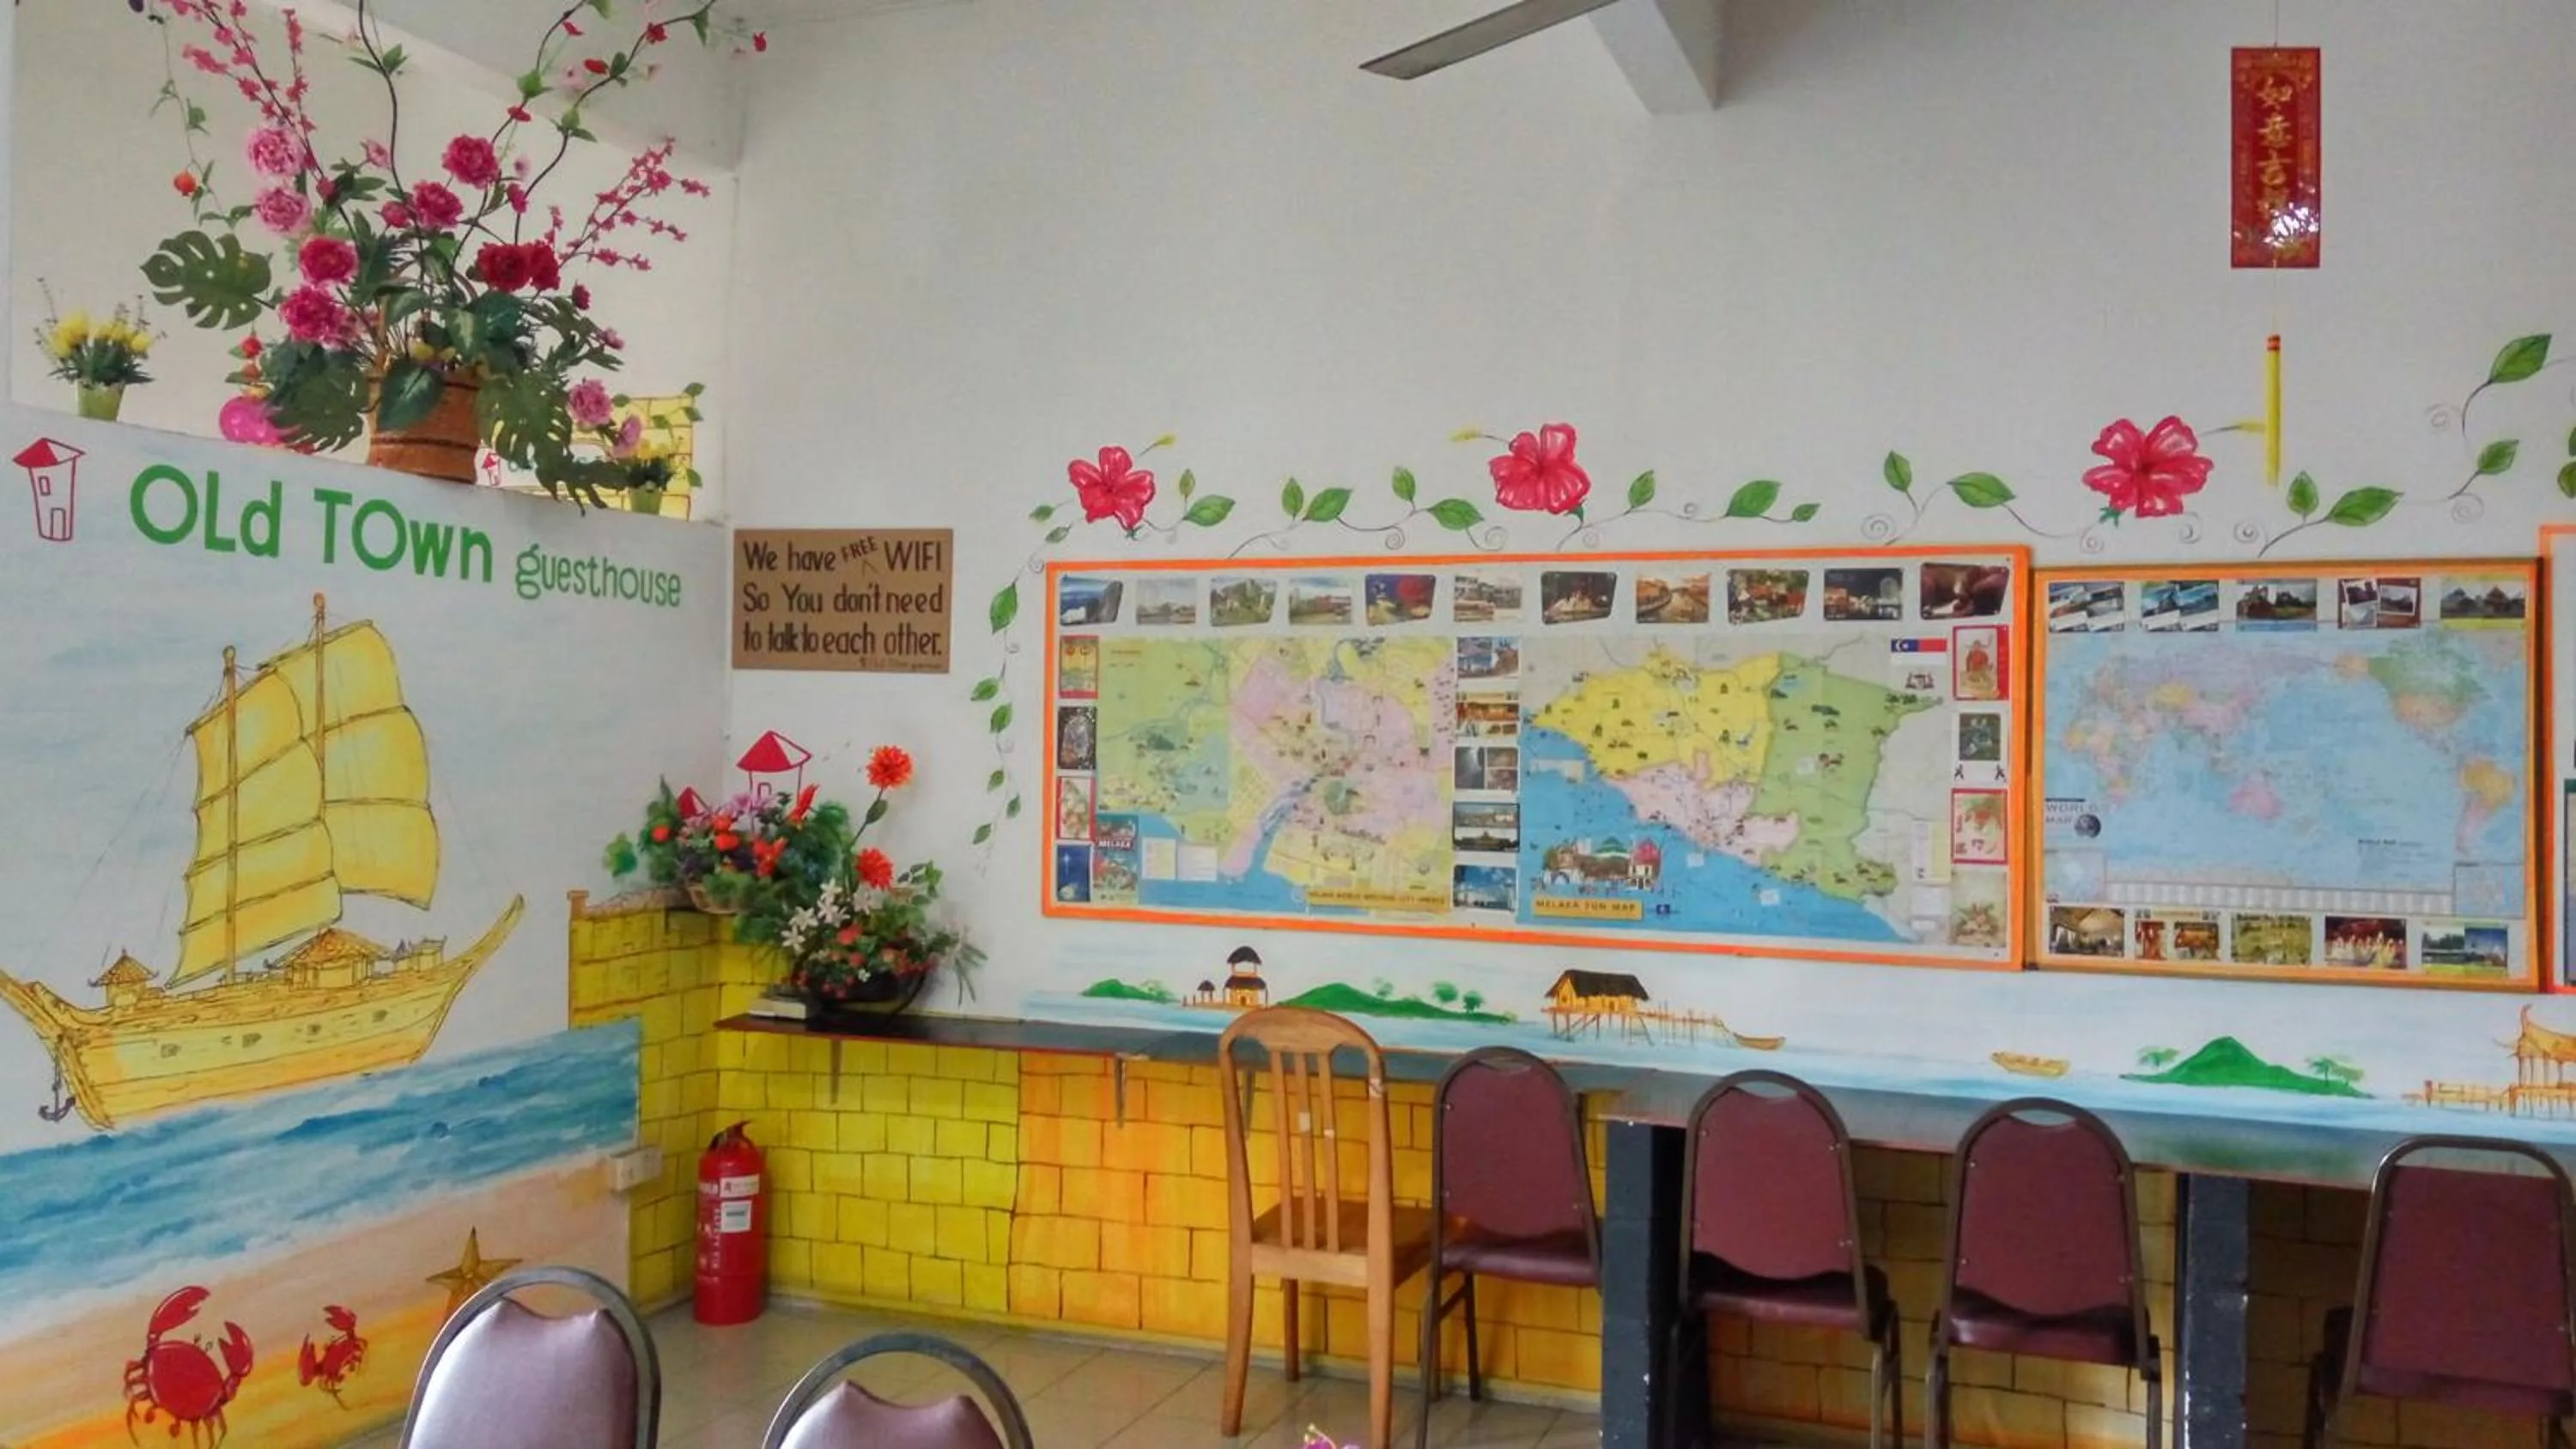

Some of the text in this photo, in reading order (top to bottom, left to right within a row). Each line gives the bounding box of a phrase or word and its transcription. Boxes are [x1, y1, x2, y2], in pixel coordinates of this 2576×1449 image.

[743, 536, 942, 572] We have FREE WIFI
[515, 543, 682, 609] guesthouse
[743, 582, 943, 613] So You don't need
[743, 621, 762, 652] to
[801, 621, 819, 652] to
[822, 621, 877, 655] each
[883, 622, 942, 656] other.
